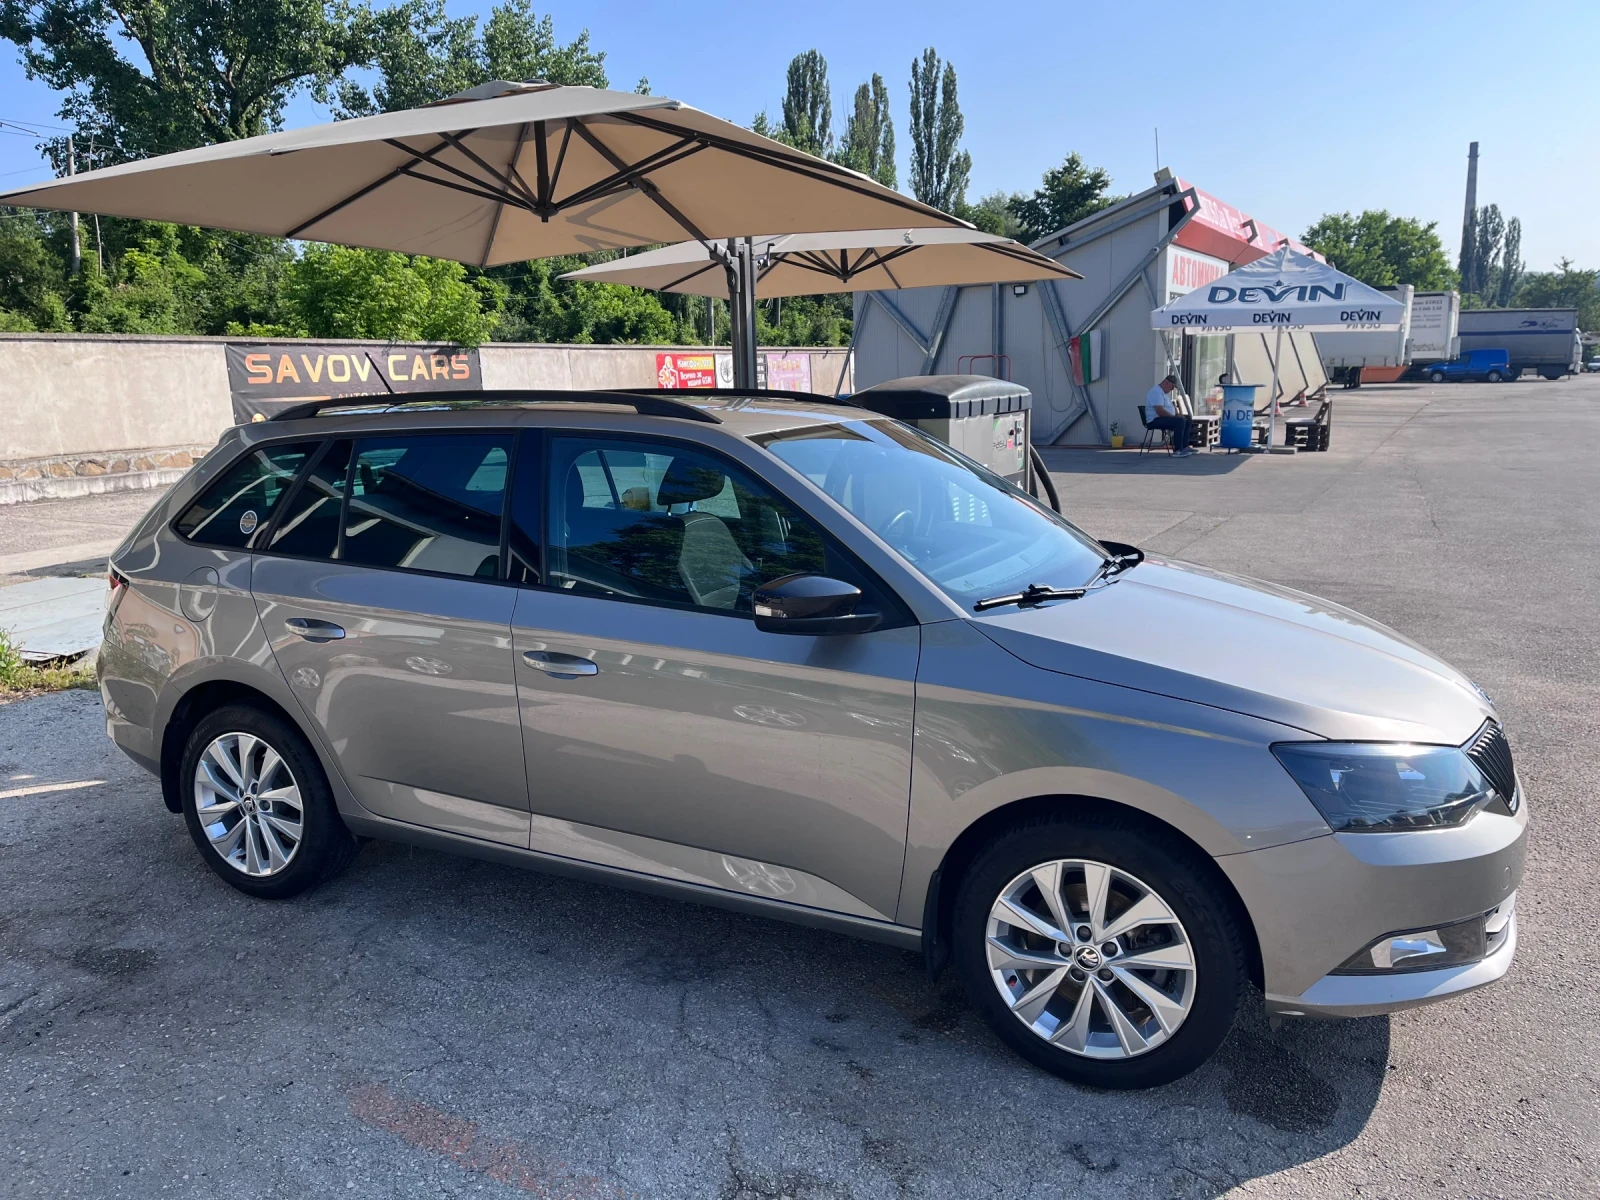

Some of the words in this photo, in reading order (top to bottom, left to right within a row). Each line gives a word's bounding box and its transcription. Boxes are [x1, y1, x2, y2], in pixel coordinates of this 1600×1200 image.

[1207, 280, 1347, 304] DEVIN
[1171, 313, 1207, 325] DEVIN
[1252, 311, 1291, 323] DEVIN
[1340, 309, 1381, 321] DEVIN
[244, 353, 373, 384] SAVOV
[387, 354, 470, 381] CARS
